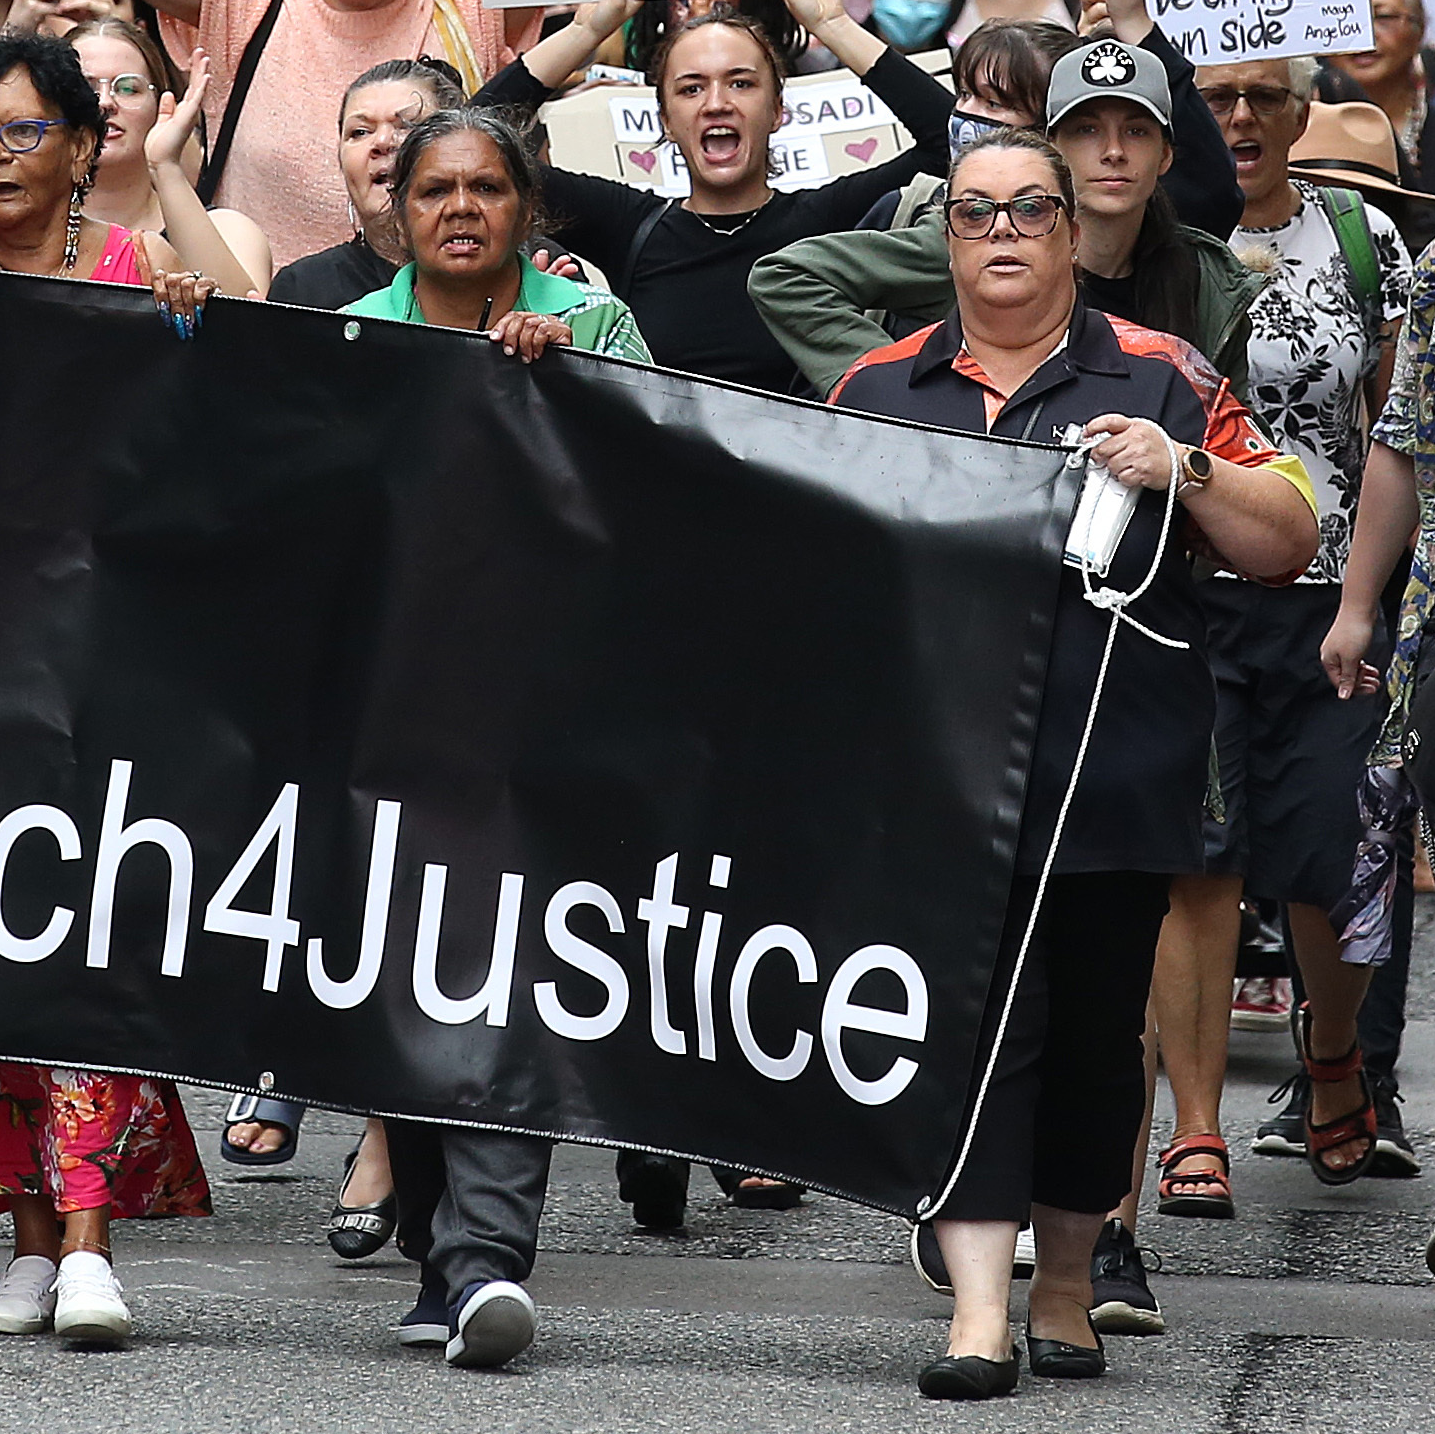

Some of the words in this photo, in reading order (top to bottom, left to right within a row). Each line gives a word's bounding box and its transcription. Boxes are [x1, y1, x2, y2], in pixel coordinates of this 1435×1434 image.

[1321, 3, 1354, 20] Maya
[1171, 27, 1208, 56] wn
[1220, 7, 1286, 53] side
[1305, 18, 1361, 47] Angelou
[1084, 44, 1134, 68] CELTICS
